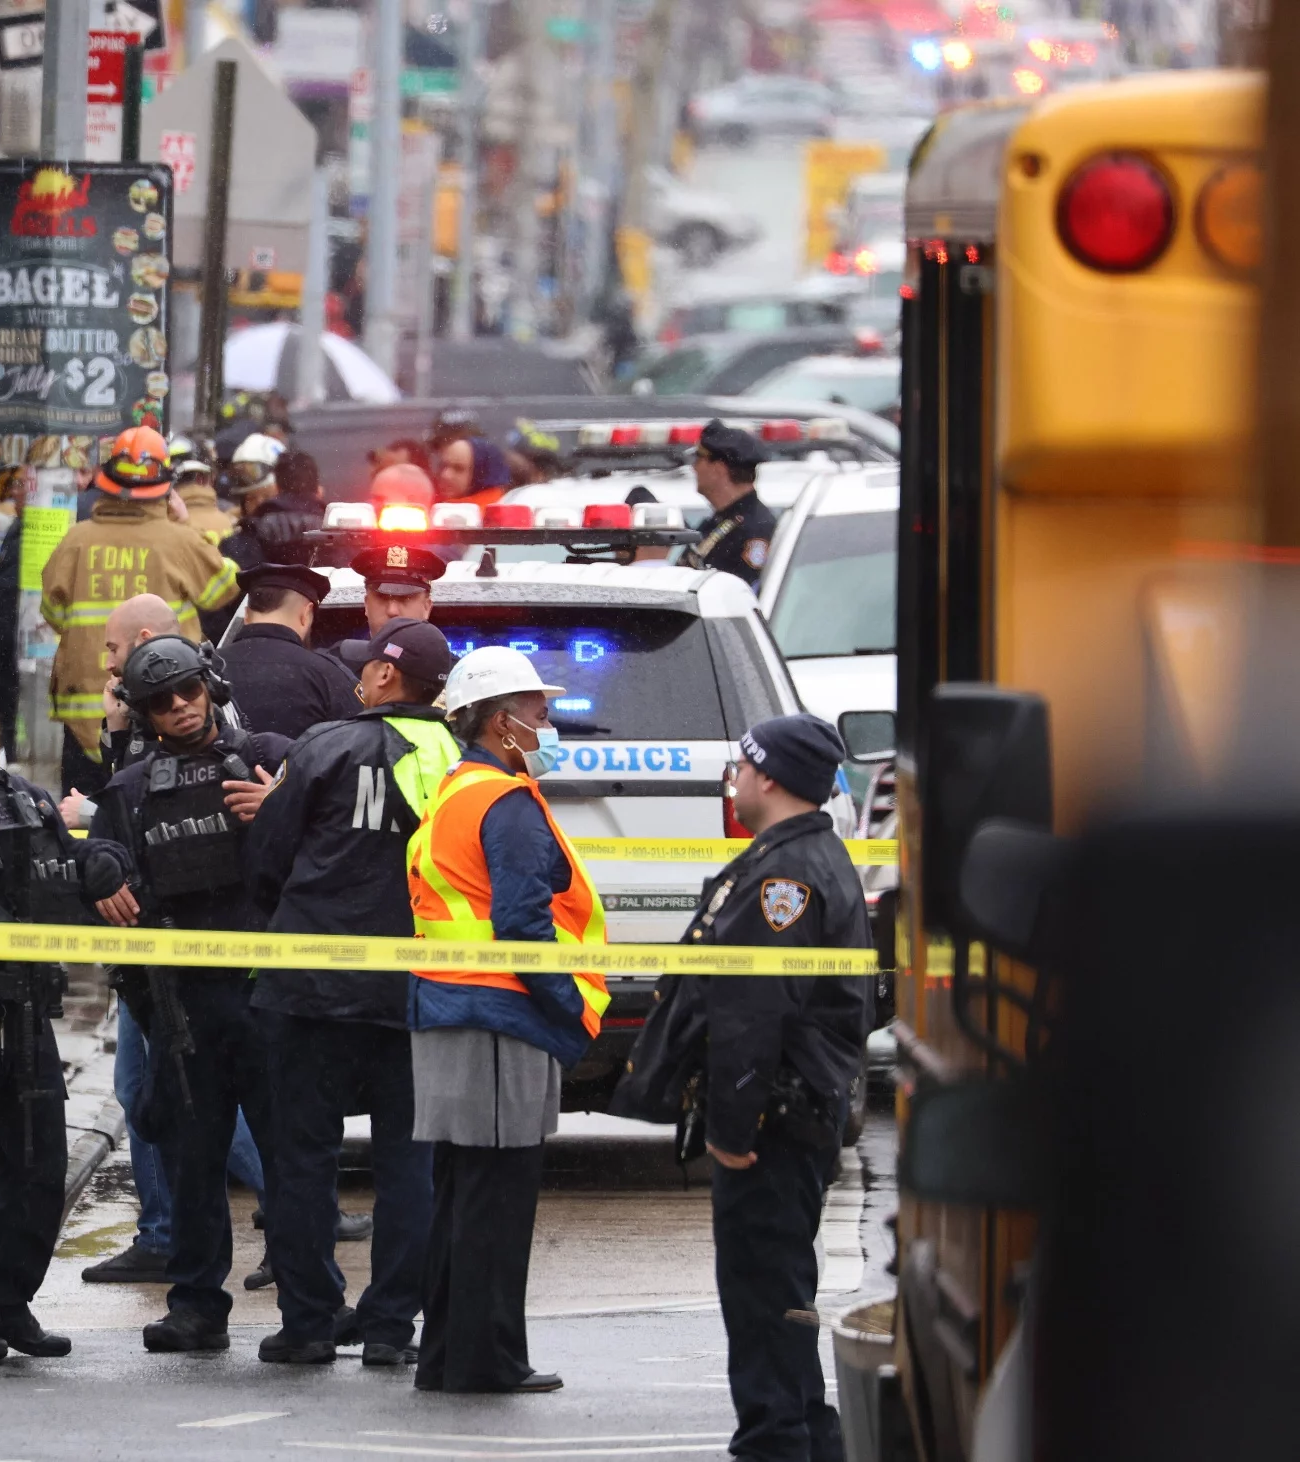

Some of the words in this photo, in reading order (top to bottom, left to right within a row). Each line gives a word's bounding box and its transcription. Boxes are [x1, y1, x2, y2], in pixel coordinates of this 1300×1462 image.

[88, 36, 126, 50] OPPING
[27, 309, 68, 325] WITH
[46, 328, 120, 353] BUTTER
[65, 357, 116, 406] $2
[89, 545, 150, 571] FDNY
[91, 573, 148, 599] EMS
[551, 747, 691, 773] POLICE
[620, 897, 641, 907] PAL
[644, 897, 697, 908] INSPIRES
